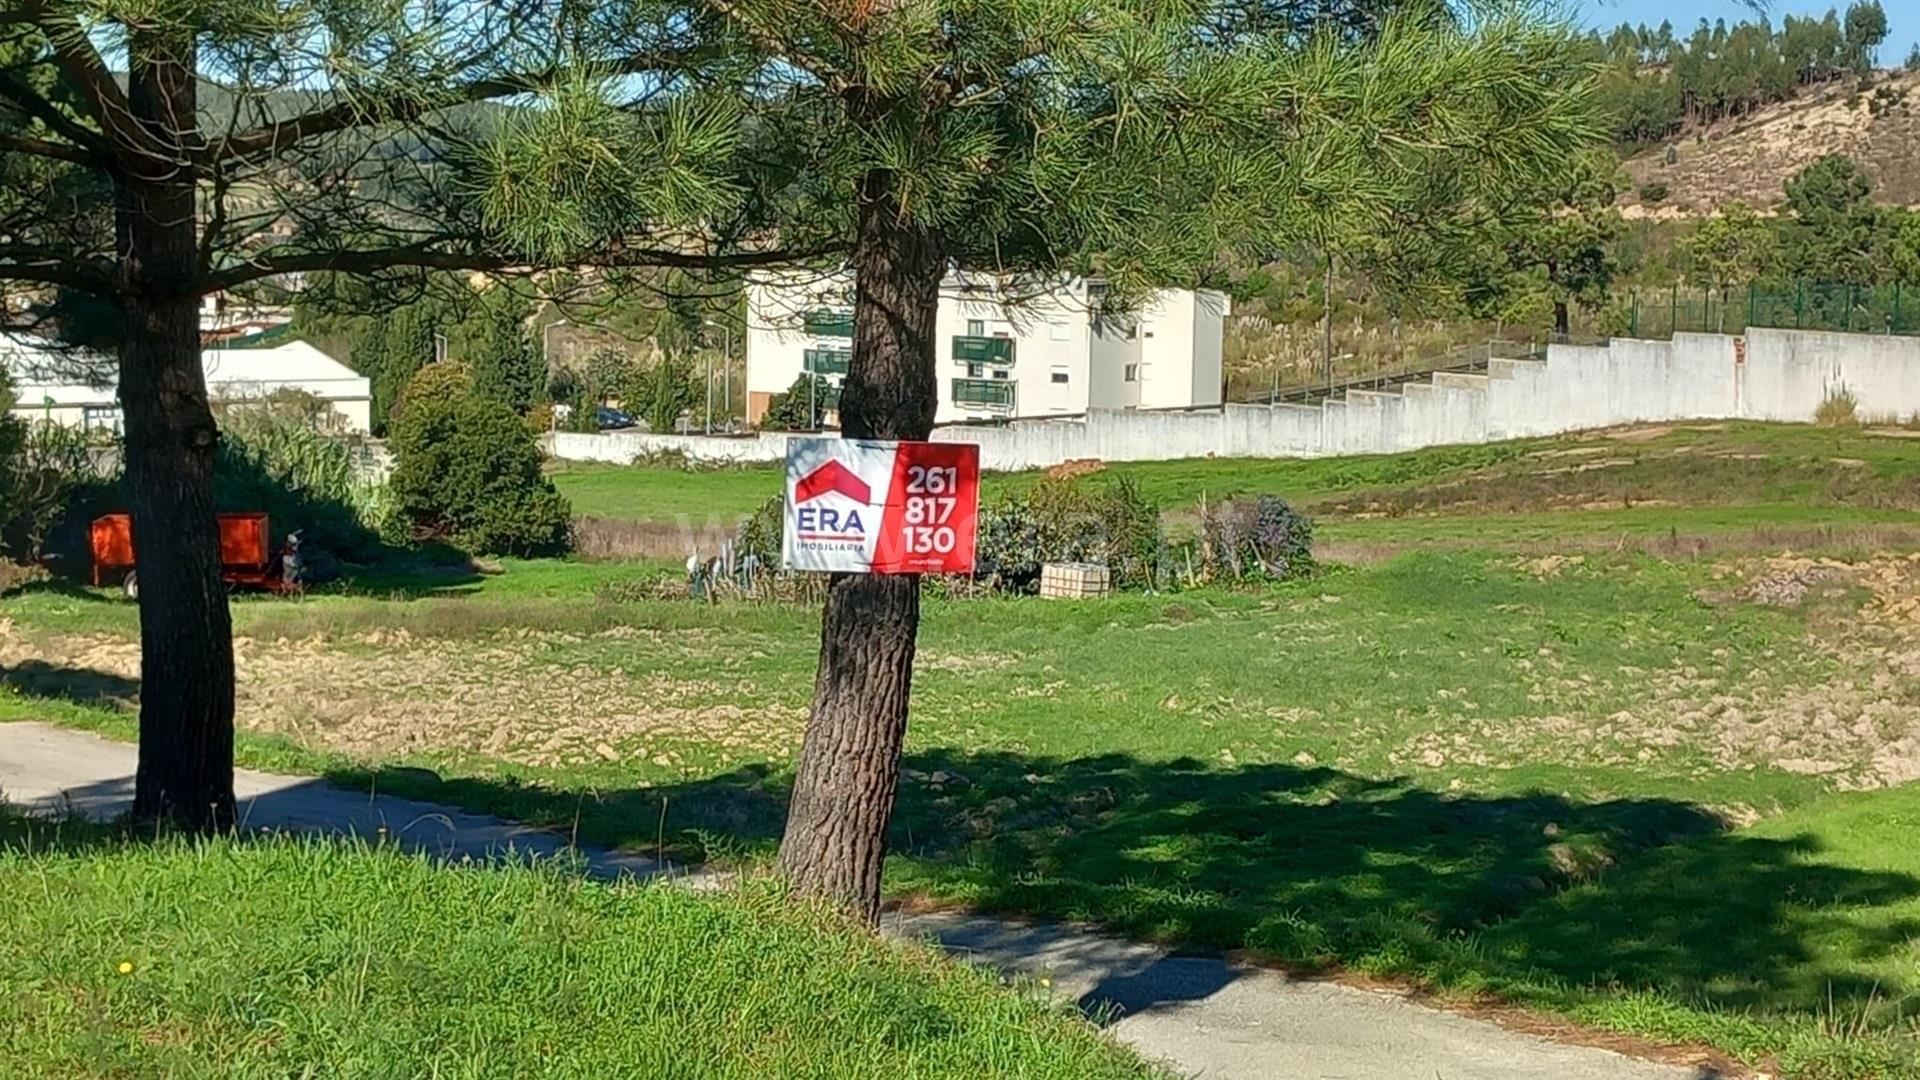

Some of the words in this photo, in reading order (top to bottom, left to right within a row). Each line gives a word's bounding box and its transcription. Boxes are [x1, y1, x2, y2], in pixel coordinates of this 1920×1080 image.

[906, 466, 957, 494] 261
[798, 508, 866, 533] ERA
[905, 497, 957, 525] 817
[903, 527, 956, 554] 130
